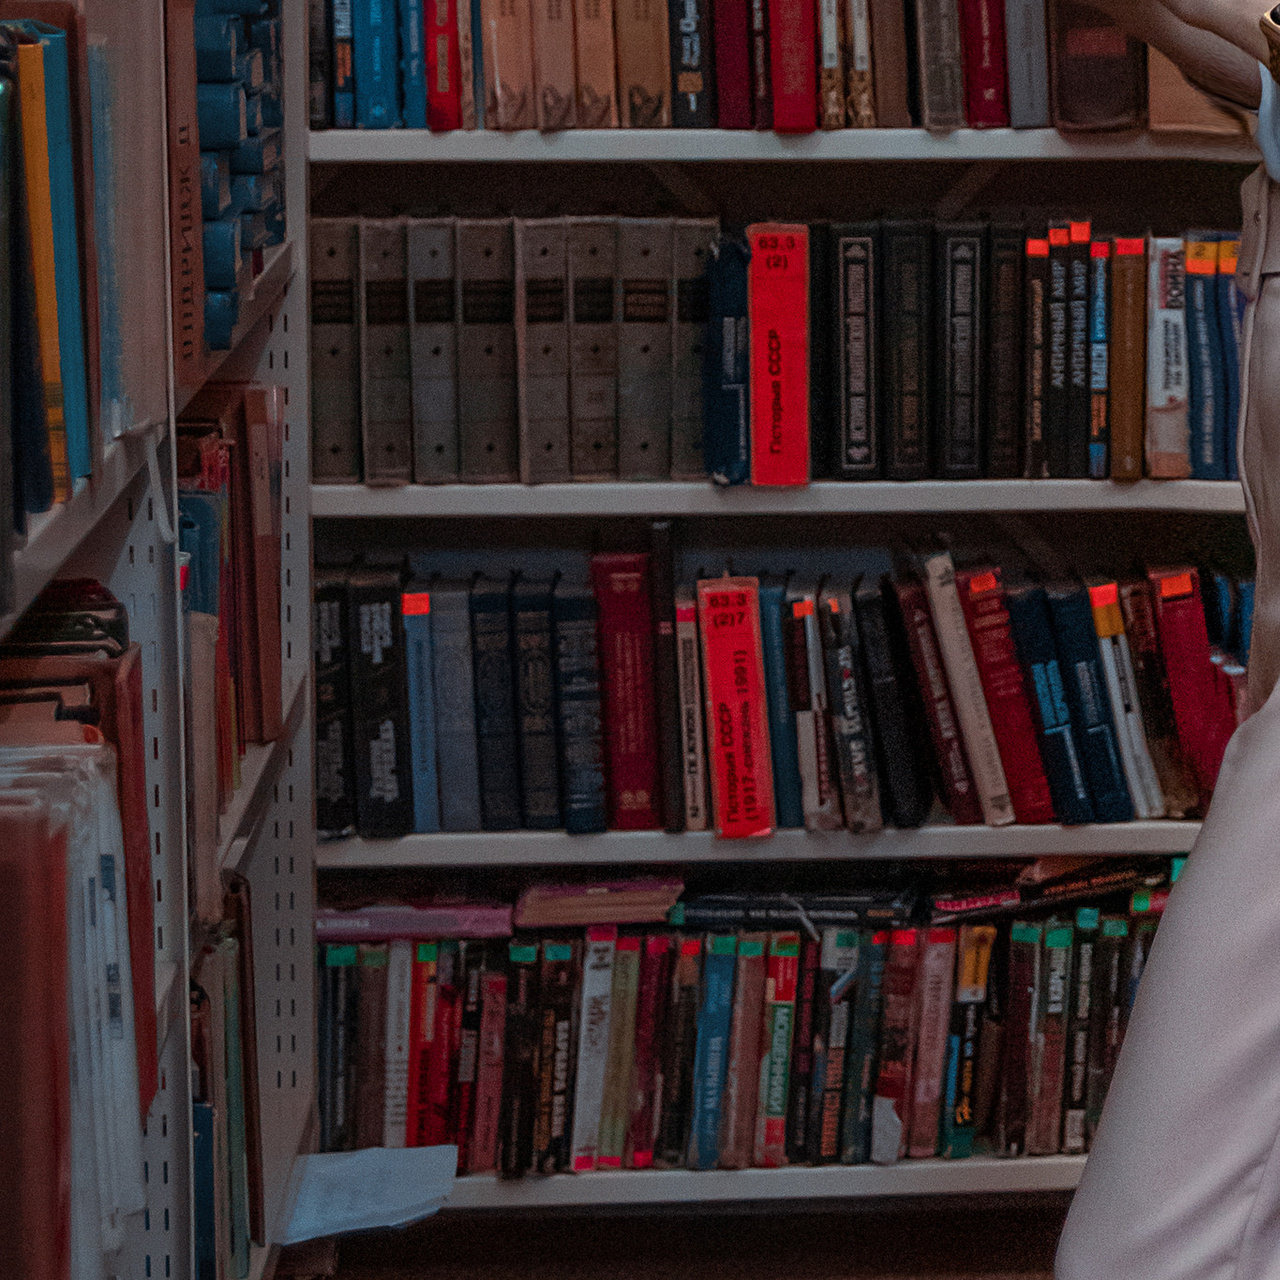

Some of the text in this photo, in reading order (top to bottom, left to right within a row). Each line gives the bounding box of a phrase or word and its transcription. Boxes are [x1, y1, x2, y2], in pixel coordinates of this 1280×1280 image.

[765, 328, 784, 376] СССР
[1049, 260, 1066, 387] АНТИЧНЫЙ МИР
[1068, 259, 1088, 385] АНТИЧНЫЙ МИР
[717, 701, 738, 747] СССР
